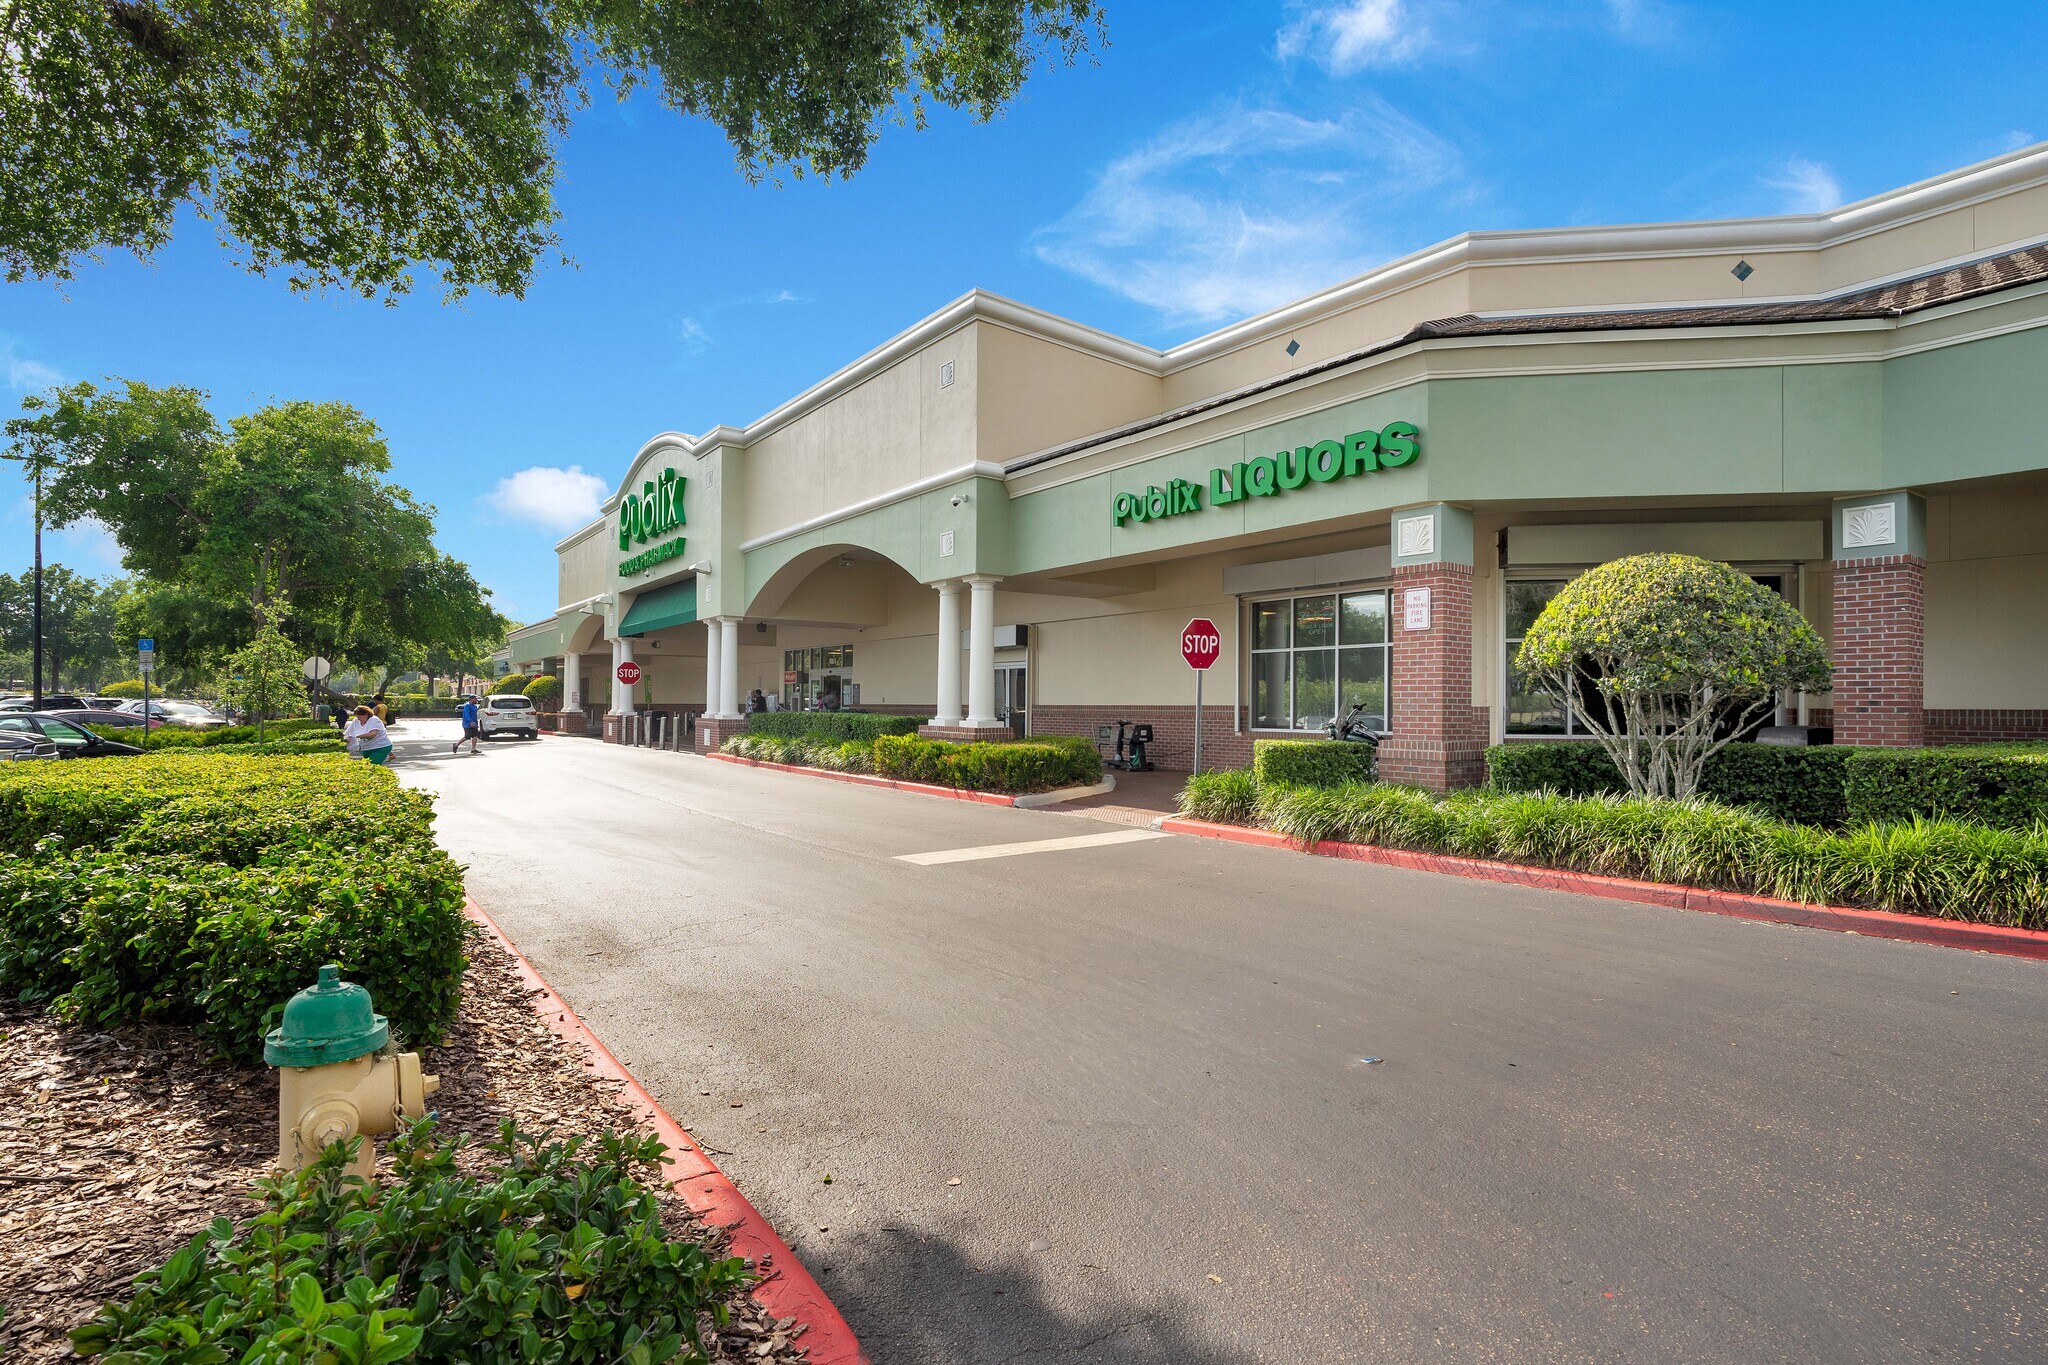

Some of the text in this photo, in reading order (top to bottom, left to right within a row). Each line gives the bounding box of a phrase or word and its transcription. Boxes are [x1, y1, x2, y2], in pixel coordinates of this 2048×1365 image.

[1113, 420, 1421, 527] Publix LIQUORS
[619, 467, 687, 551] Publix
[640, 537, 687, 570] PHARMACY
[1184, 634, 1218, 654] STOP
[618, 668, 640, 678] STOP
